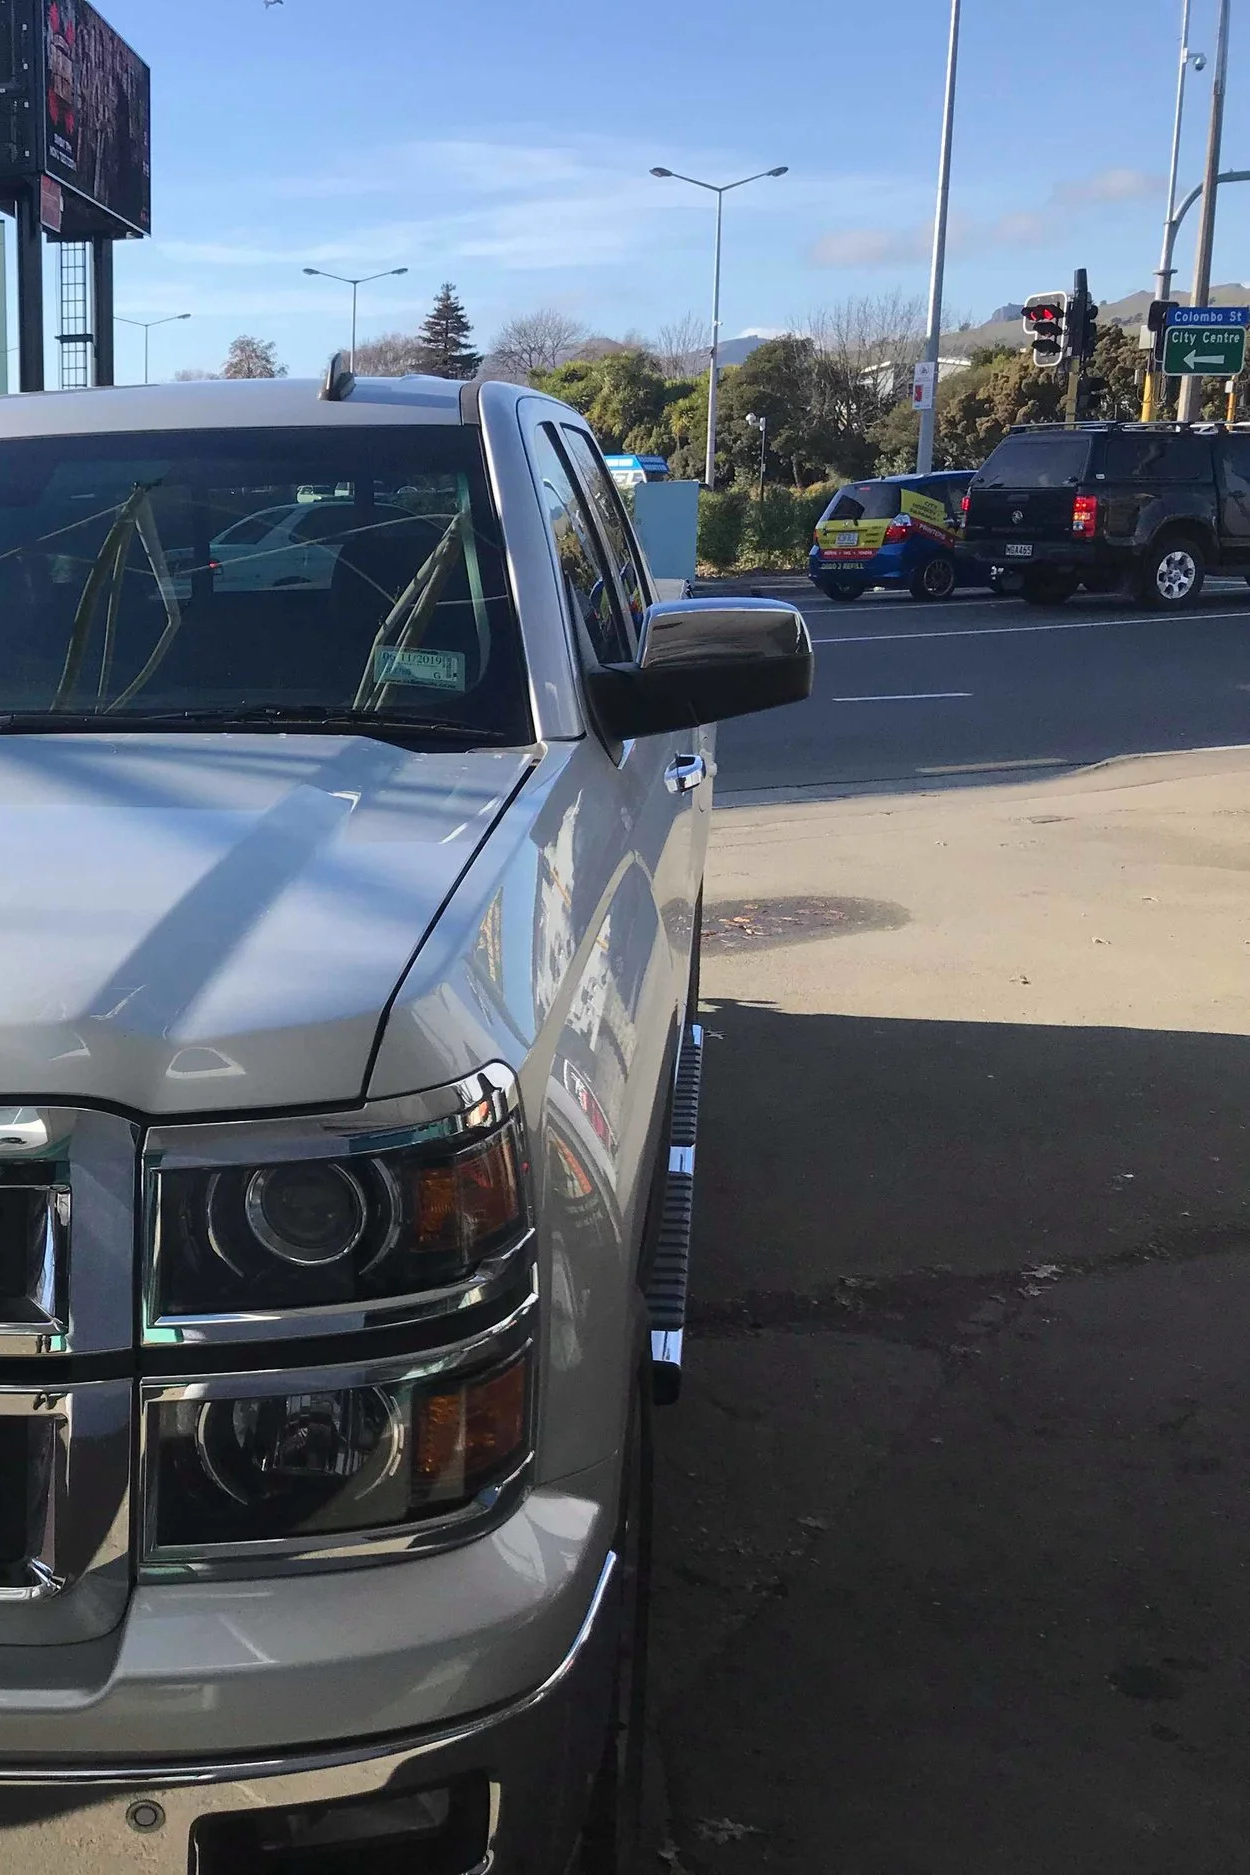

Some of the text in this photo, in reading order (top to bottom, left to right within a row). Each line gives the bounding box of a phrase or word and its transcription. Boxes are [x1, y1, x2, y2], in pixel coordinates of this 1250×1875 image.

[1174, 311, 1242, 322] Colombo St
[1171, 331, 1240, 346] City Centre
